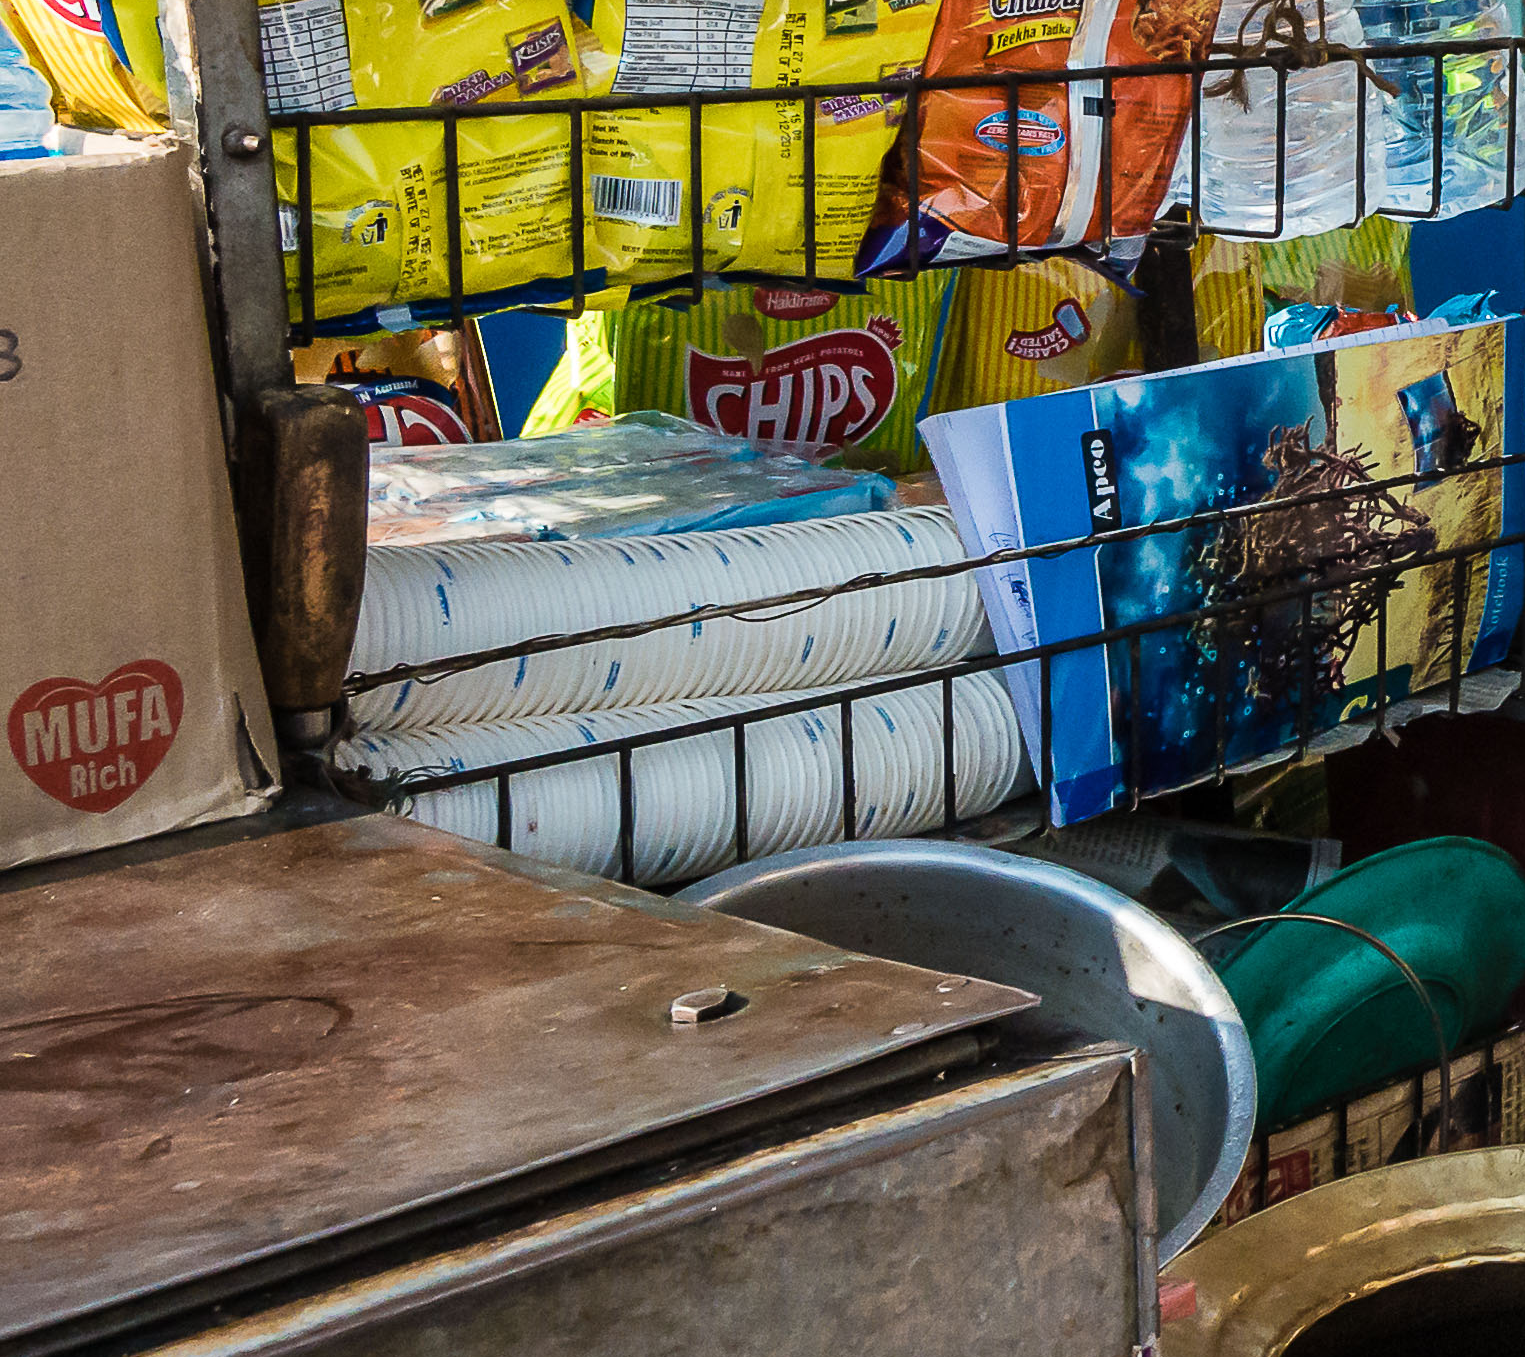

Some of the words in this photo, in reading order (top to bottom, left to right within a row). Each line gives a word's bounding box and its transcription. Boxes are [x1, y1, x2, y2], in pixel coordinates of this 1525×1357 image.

[515, 29, 561, 67] KRISPS
[996, 27, 1037, 50] Teekha
[1041, 23, 1072, 37] Tadka
[833, 98, 883, 125] MASALA
[1019, 327, 1064, 348] SALTED
[722, 370, 747, 378] MADE
[819, 347, 865, 357] POTATOES
[705, 363, 877, 444] CHIPS
[1089, 438, 1117, 521] Apco
[22, 684, 174, 768] MUFA
[69, 753, 138, 799] Rich
